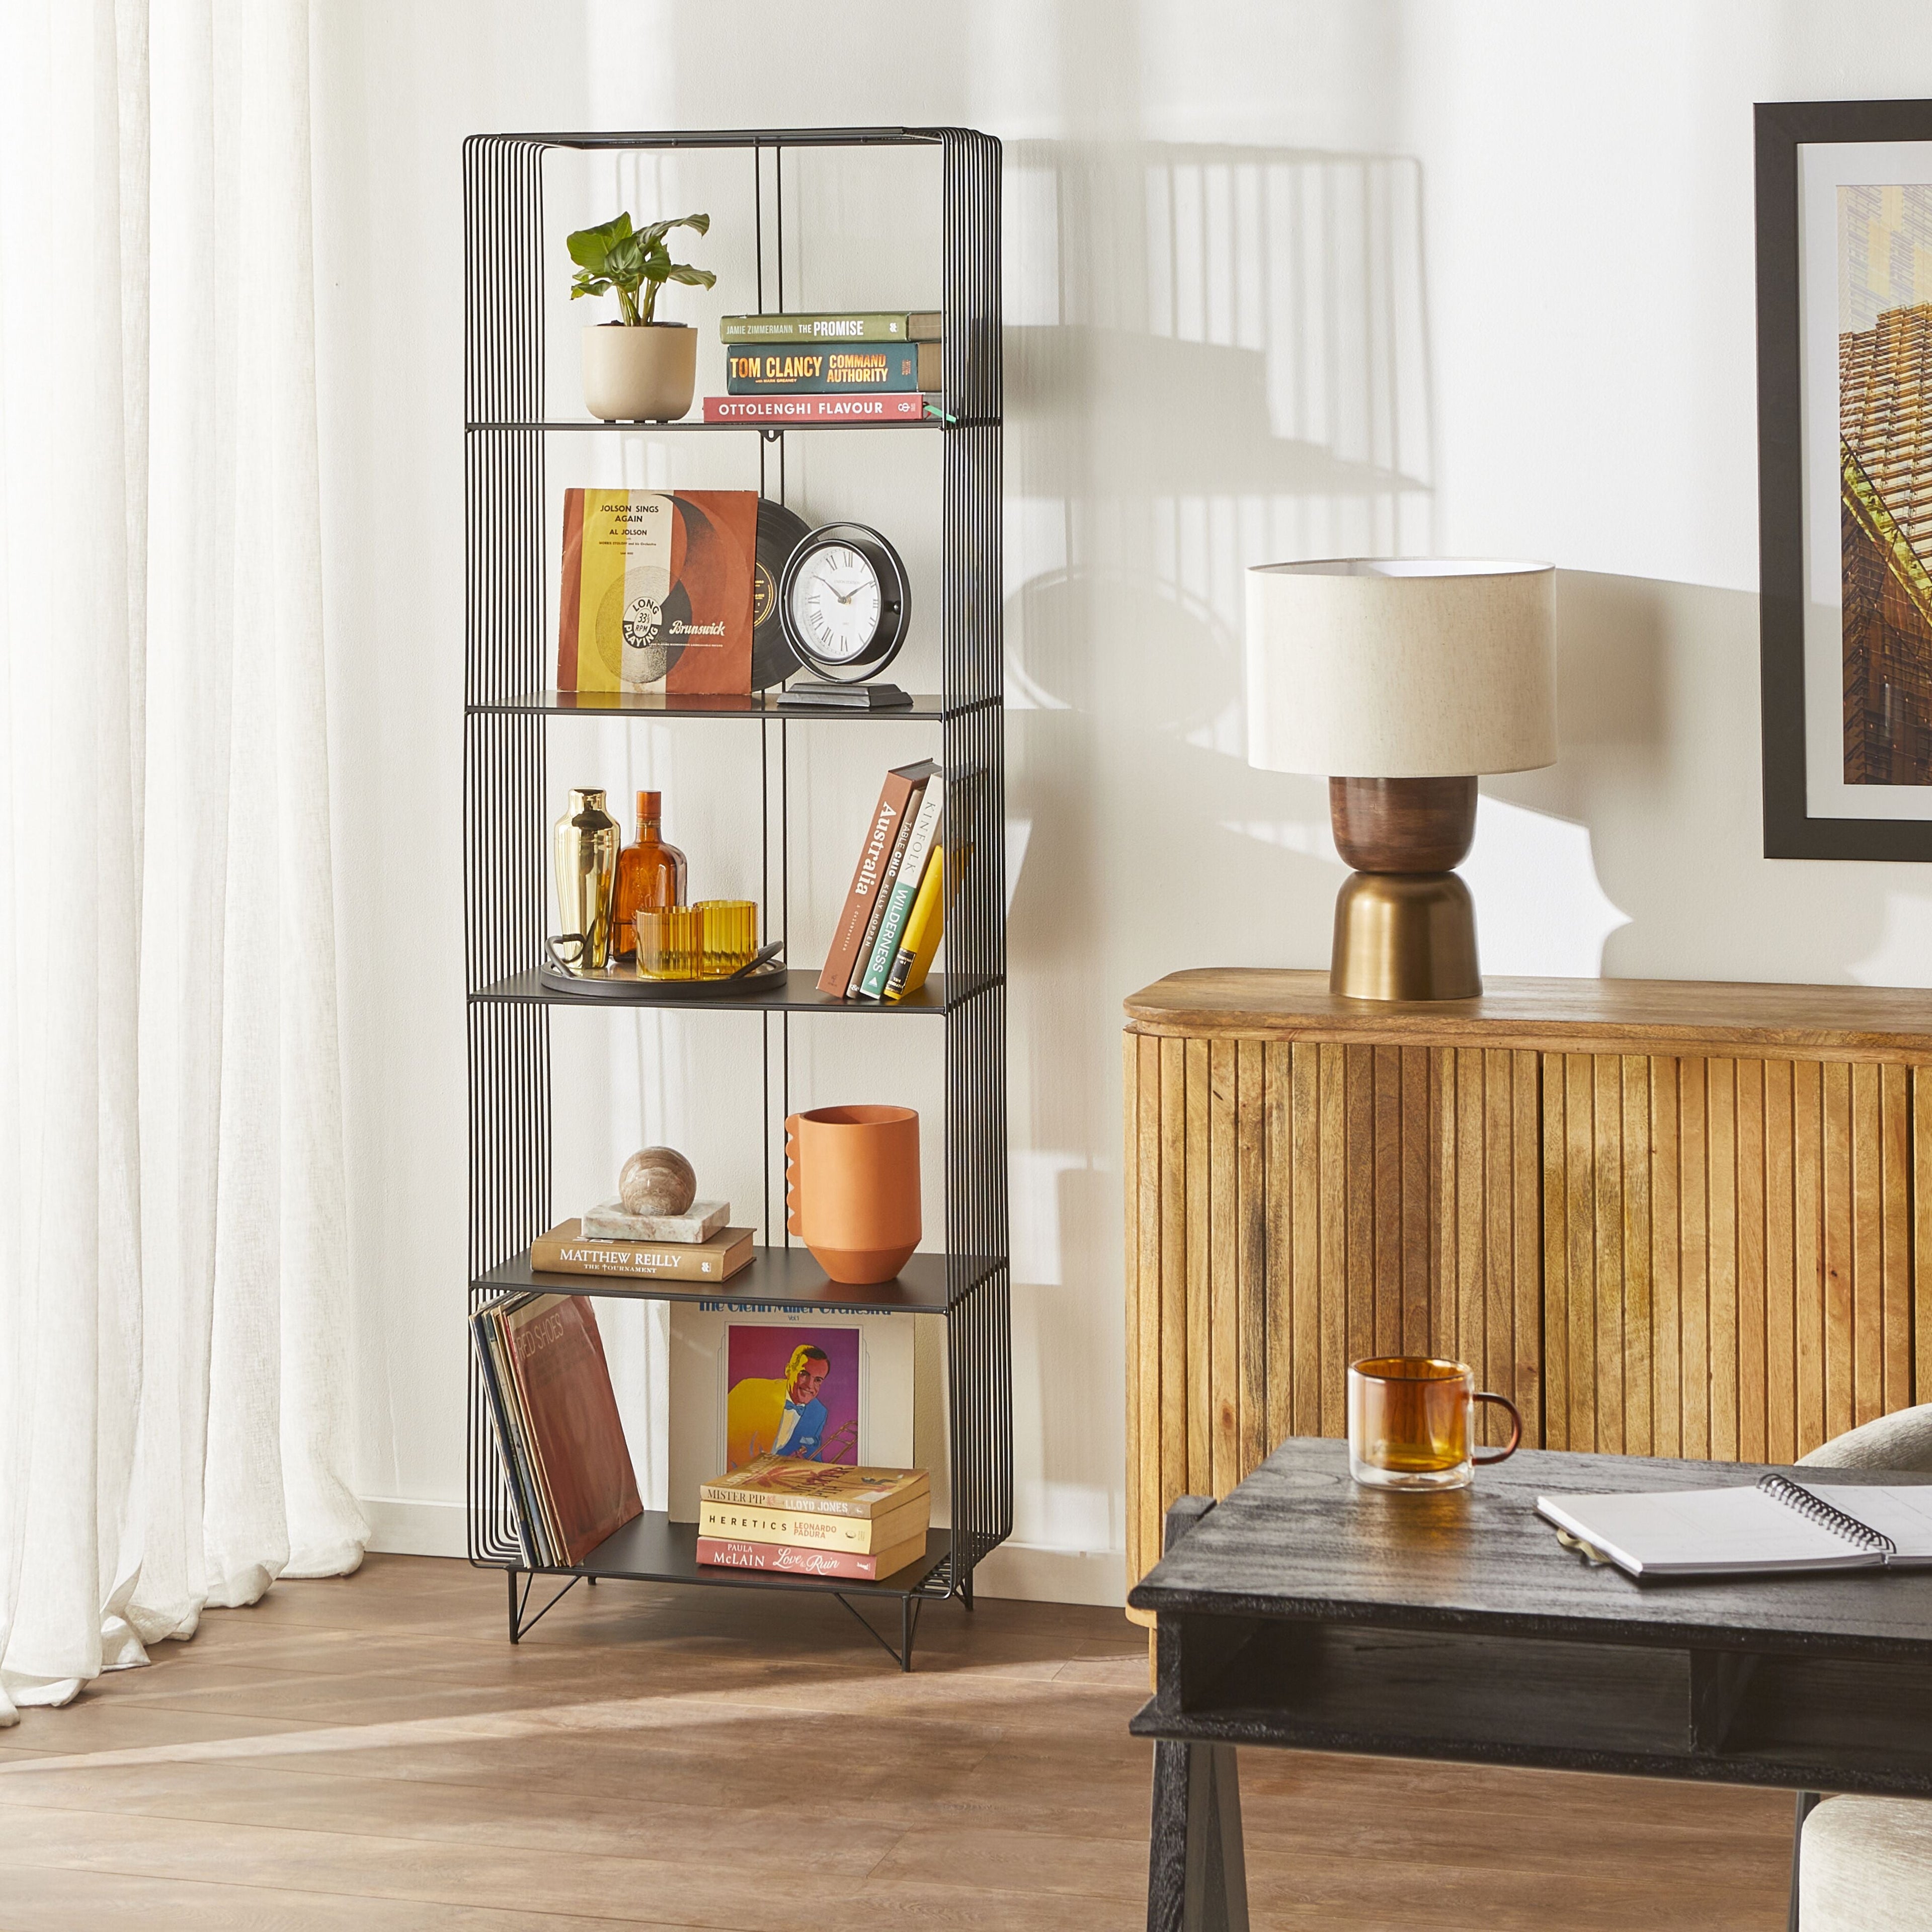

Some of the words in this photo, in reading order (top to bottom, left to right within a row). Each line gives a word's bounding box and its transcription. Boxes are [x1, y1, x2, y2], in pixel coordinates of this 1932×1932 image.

[726, 326, 746, 335] JAMIE
[747, 325, 793, 334] ZIMMERMANN
[798, 324, 812, 334] THE
[814, 320, 864, 336] PROMISE
[730, 357, 761, 378] TOM
[766, 356, 823, 378] CLANCY
[829, 354, 887, 369] COMMAND
[827, 367, 889, 383] AUTHORITY
[718, 403, 811, 416] OTTOLENGHI
[818, 402, 883, 414] FLAVOUR
[632, 599, 660, 615] LONG
[624, 623, 659, 647] PLAYING
[635, 624, 648, 632] RPM
[669, 620, 726, 636] Brunswick
[898, 822, 912, 849] TABLE
[905, 801, 936, 873] KINFOLK
[855, 800, 897, 895] Australia
[889, 851, 902, 877] CHIC
[877, 883, 890, 910] KELLY
[865, 913, 880, 947] HOPPEN
[873, 889, 909, 973] WILDERNESS
[559, 1248, 631, 1264] MATTHEW
[635, 1253, 682, 1268] REILLY
[602, 1263, 657, 1274] TOURNAMENT
[516, 1331, 536, 1361] RED
[534, 1313, 564, 1350] SHOES
[707, 1489, 746, 1503] MISTER
[749, 1493, 765, 1504] PIP
[785, 1499, 815, 1511] LLOYD
[817, 1500, 849, 1513] JONES
[709, 1515, 787, 1531] HERETICS
[794, 1521, 837, 1533] LEONARDO
[793, 1528, 826, 1539] PADURA
[728, 1543, 753, 1553] PAULA
[713, 1551, 765, 1567] McLAIN
[772, 1547, 803, 1569] Love
[806, 1555, 840, 1576] Ruin
